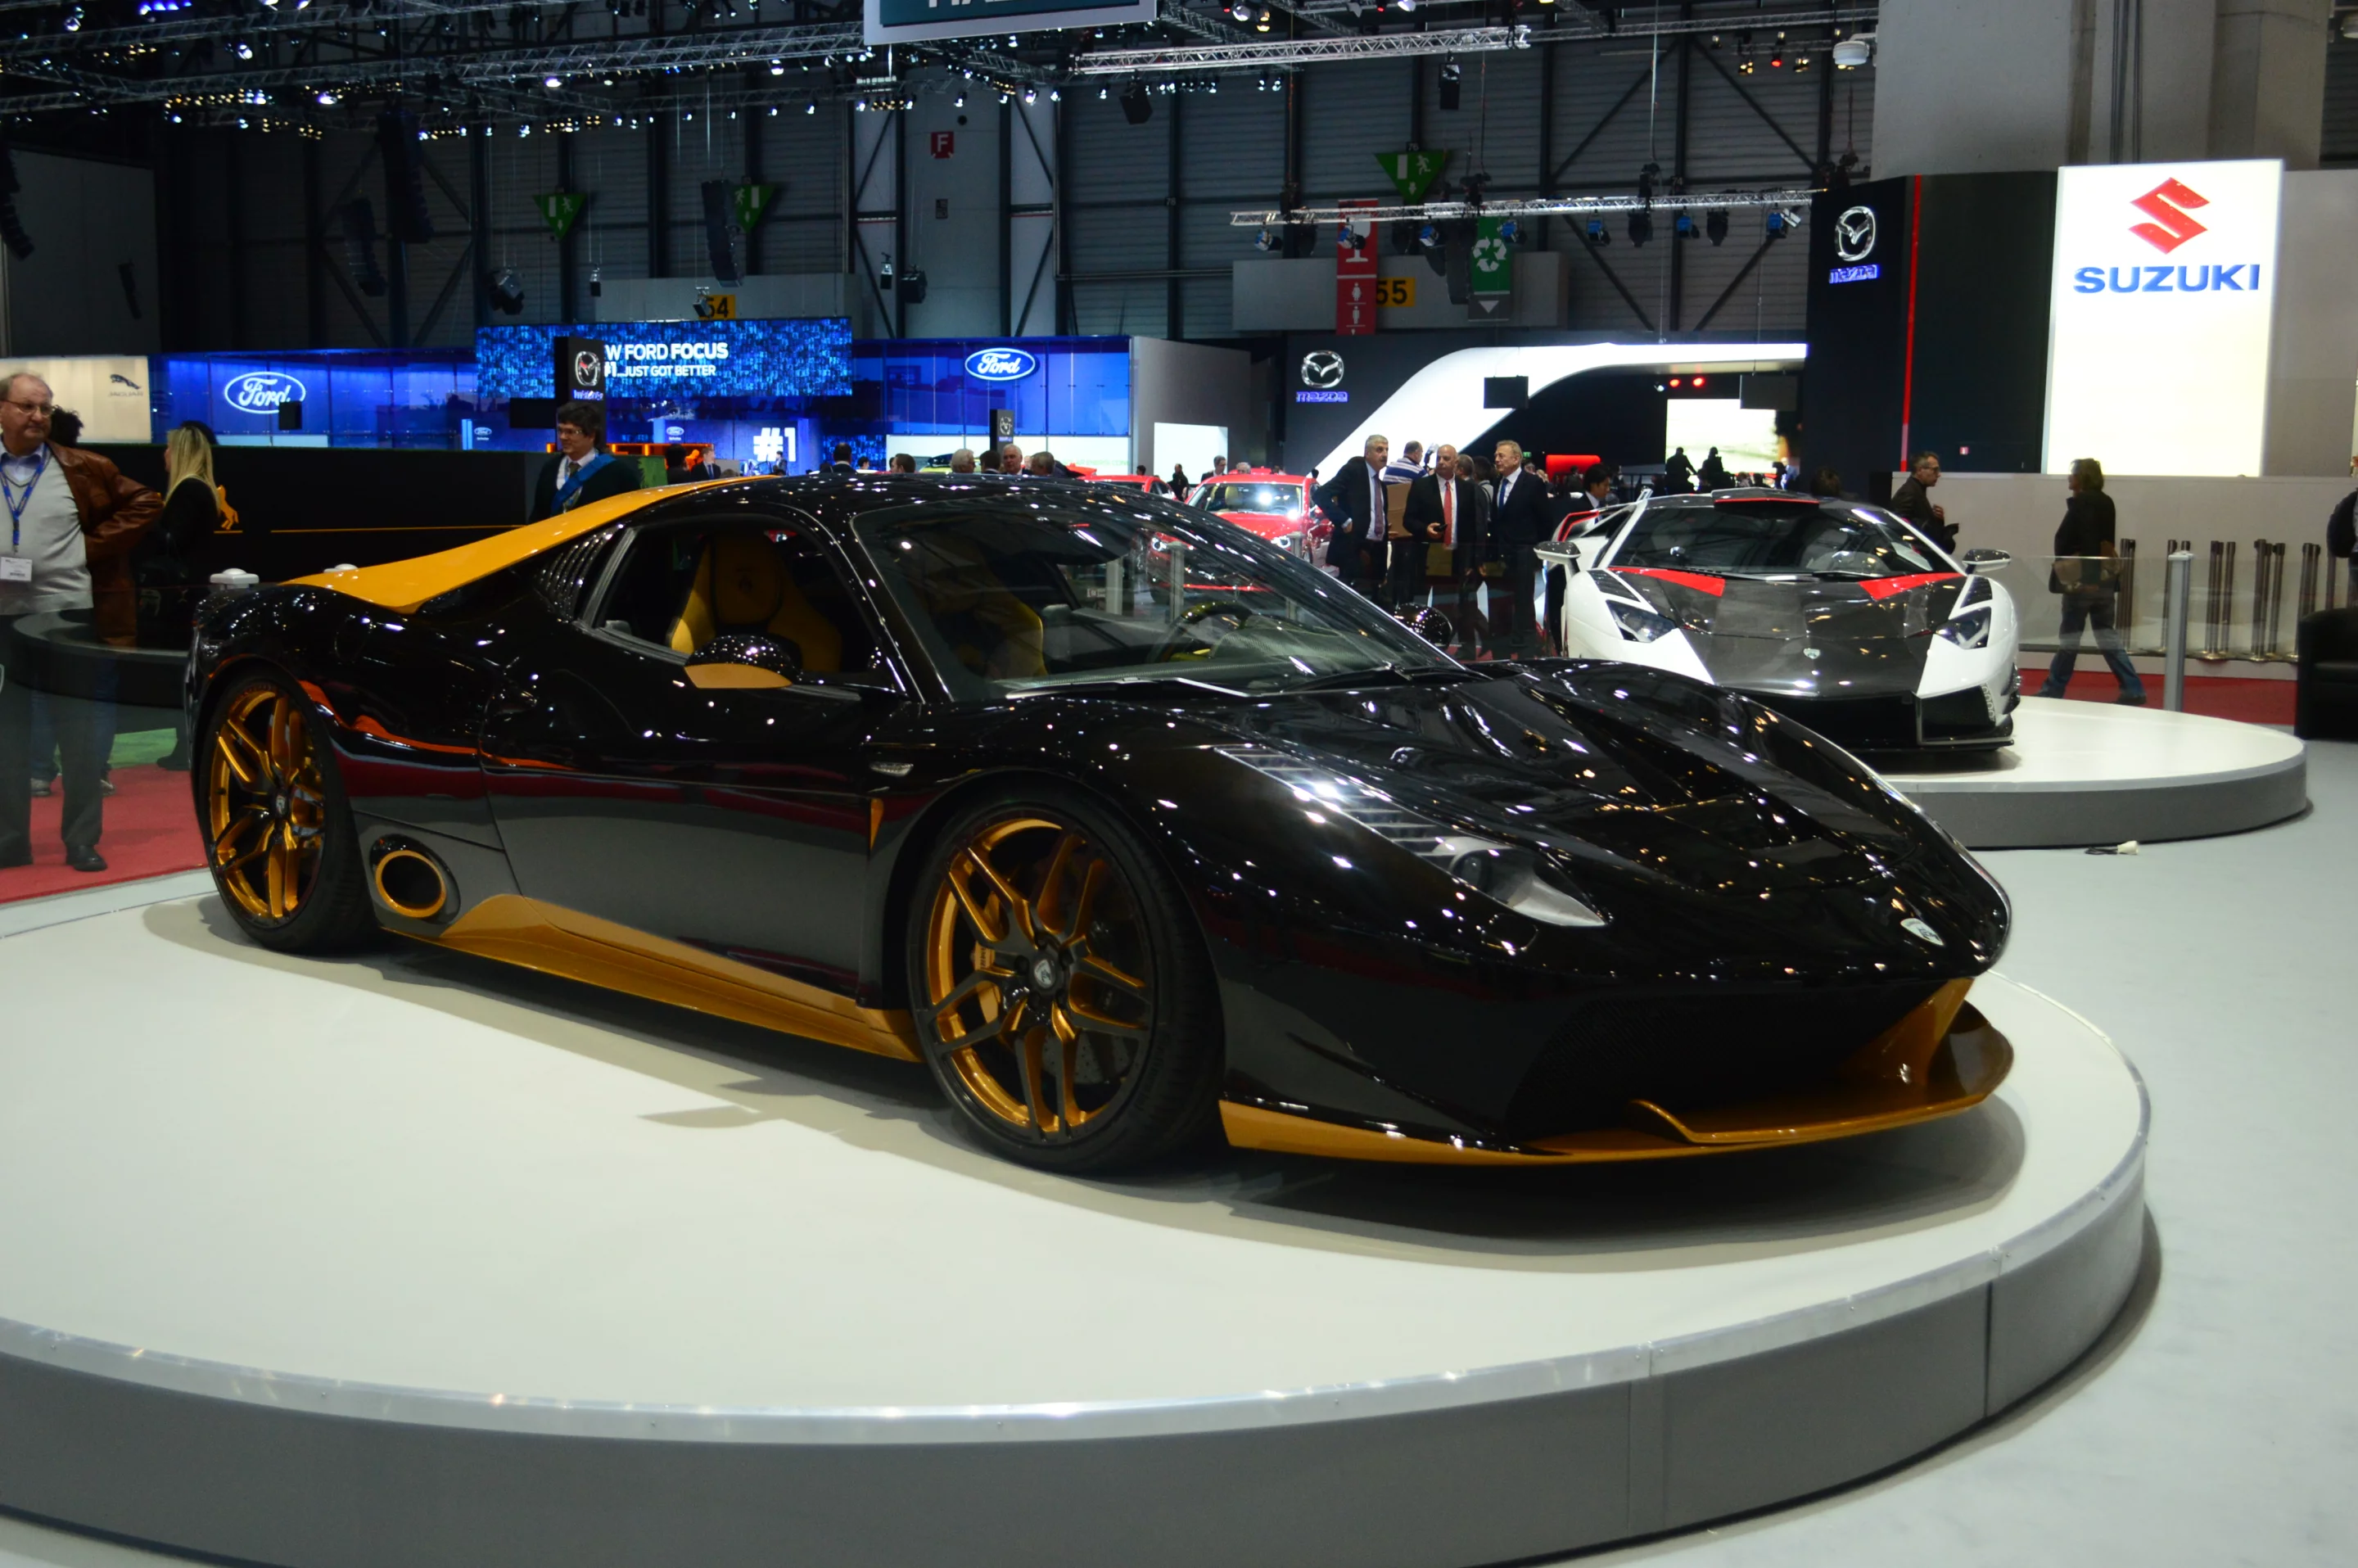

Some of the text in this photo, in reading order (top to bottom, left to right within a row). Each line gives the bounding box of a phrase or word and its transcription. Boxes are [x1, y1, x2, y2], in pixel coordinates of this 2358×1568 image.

[937, 133, 950, 153] F
[2072, 264, 2261, 294] SUZUKI
[1376, 280, 1407, 305] 55
[624, 342, 669, 360] FORD
[670, 341, 730, 359] FOCUS
[650, 364, 674, 377] GOT
[674, 364, 716, 377] BETTER
[977, 352, 1022, 374] Ford
[238, 377, 292, 407] Ford
[752, 427, 797, 463] #1
